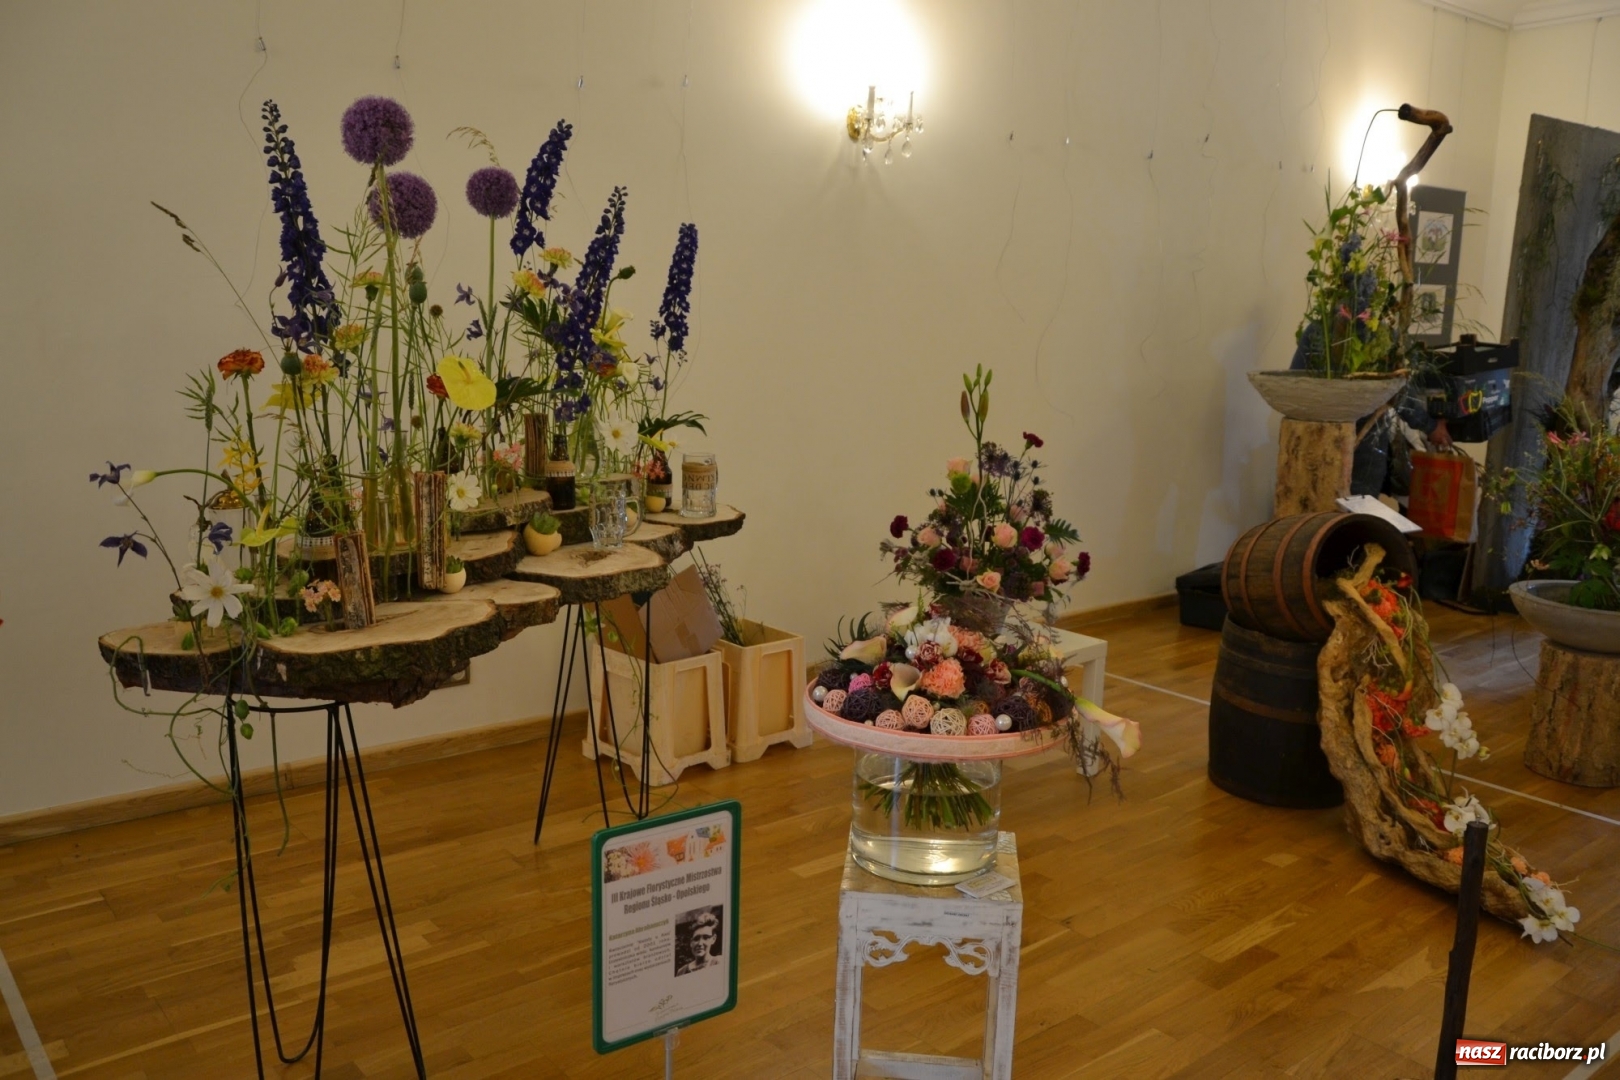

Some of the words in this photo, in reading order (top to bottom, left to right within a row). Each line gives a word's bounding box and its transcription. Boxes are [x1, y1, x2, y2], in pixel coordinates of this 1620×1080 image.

[611, 892, 619, 904] III
[619, 886, 646, 902] Krajowe
[646, 875, 686, 894] Florystyczne
[685, 866, 722, 884] Mistrzostwa
[623, 897, 651, 914] Regionu
[651, 893, 672, 907] Śląsko
[676, 883, 710, 900] Opolskiego
